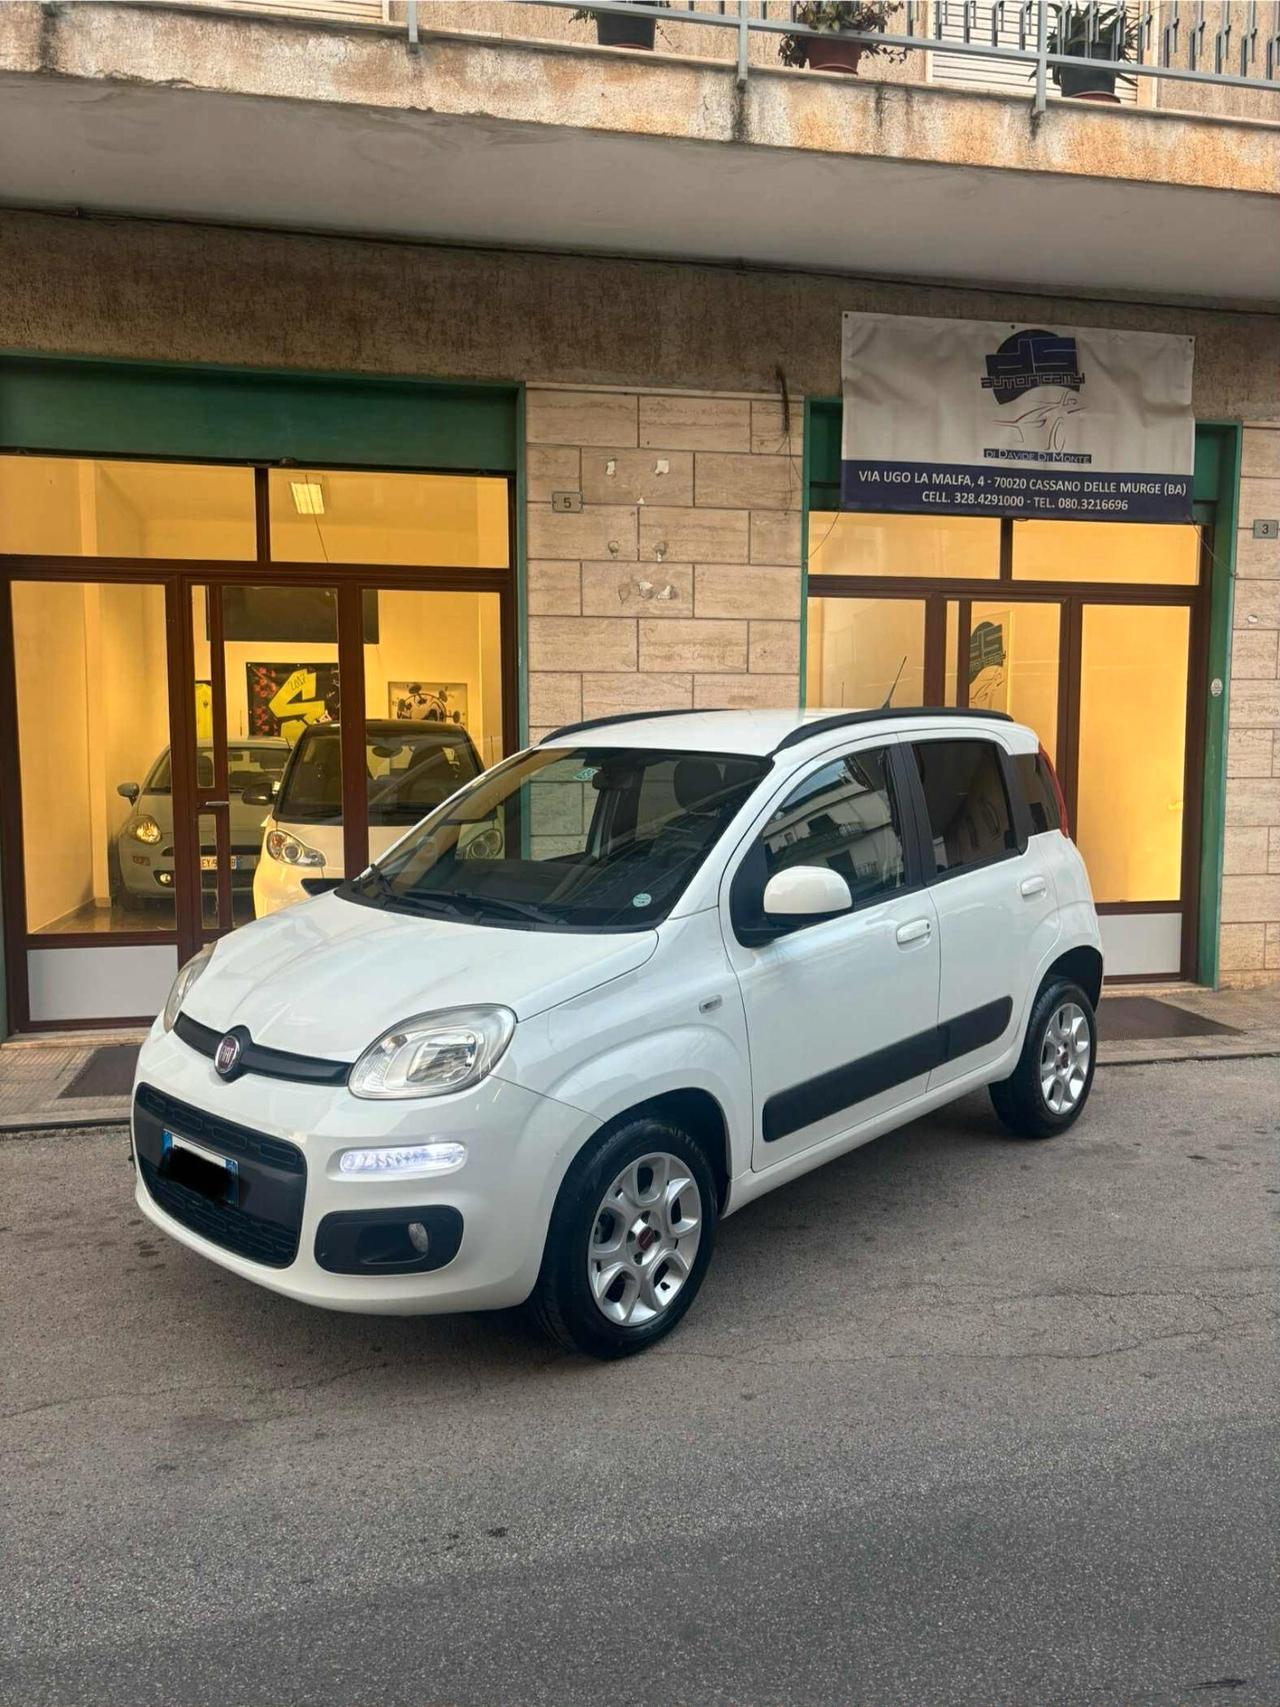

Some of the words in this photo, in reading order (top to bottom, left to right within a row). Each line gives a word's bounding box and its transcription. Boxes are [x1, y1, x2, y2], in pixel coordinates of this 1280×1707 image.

[858, 470, 880, 482] VIA
[883, 471, 911, 483] UGO
[914, 472, 929, 484] LA
[932, 473, 975, 488] MALFA,
[977, 475, 985, 487] 4
[994, 477, 1027, 489] 70020
[1029, 478, 1081, 492] CASSANO
[1084, 481, 1117, 493] DELLE
[1119, 482, 1161, 495] MURGE
[1164, 482, 1187, 497] (BA)
[563, 497, 572, 509] 5
[921, 491, 951, 503] CELL.
[954, 492, 1024, 507] 328.4291000
[1033, 497, 1055, 509] TEL.
[1057, 497, 1129, 511] 080.3216696
[1262, 523, 1269, 535] 3
